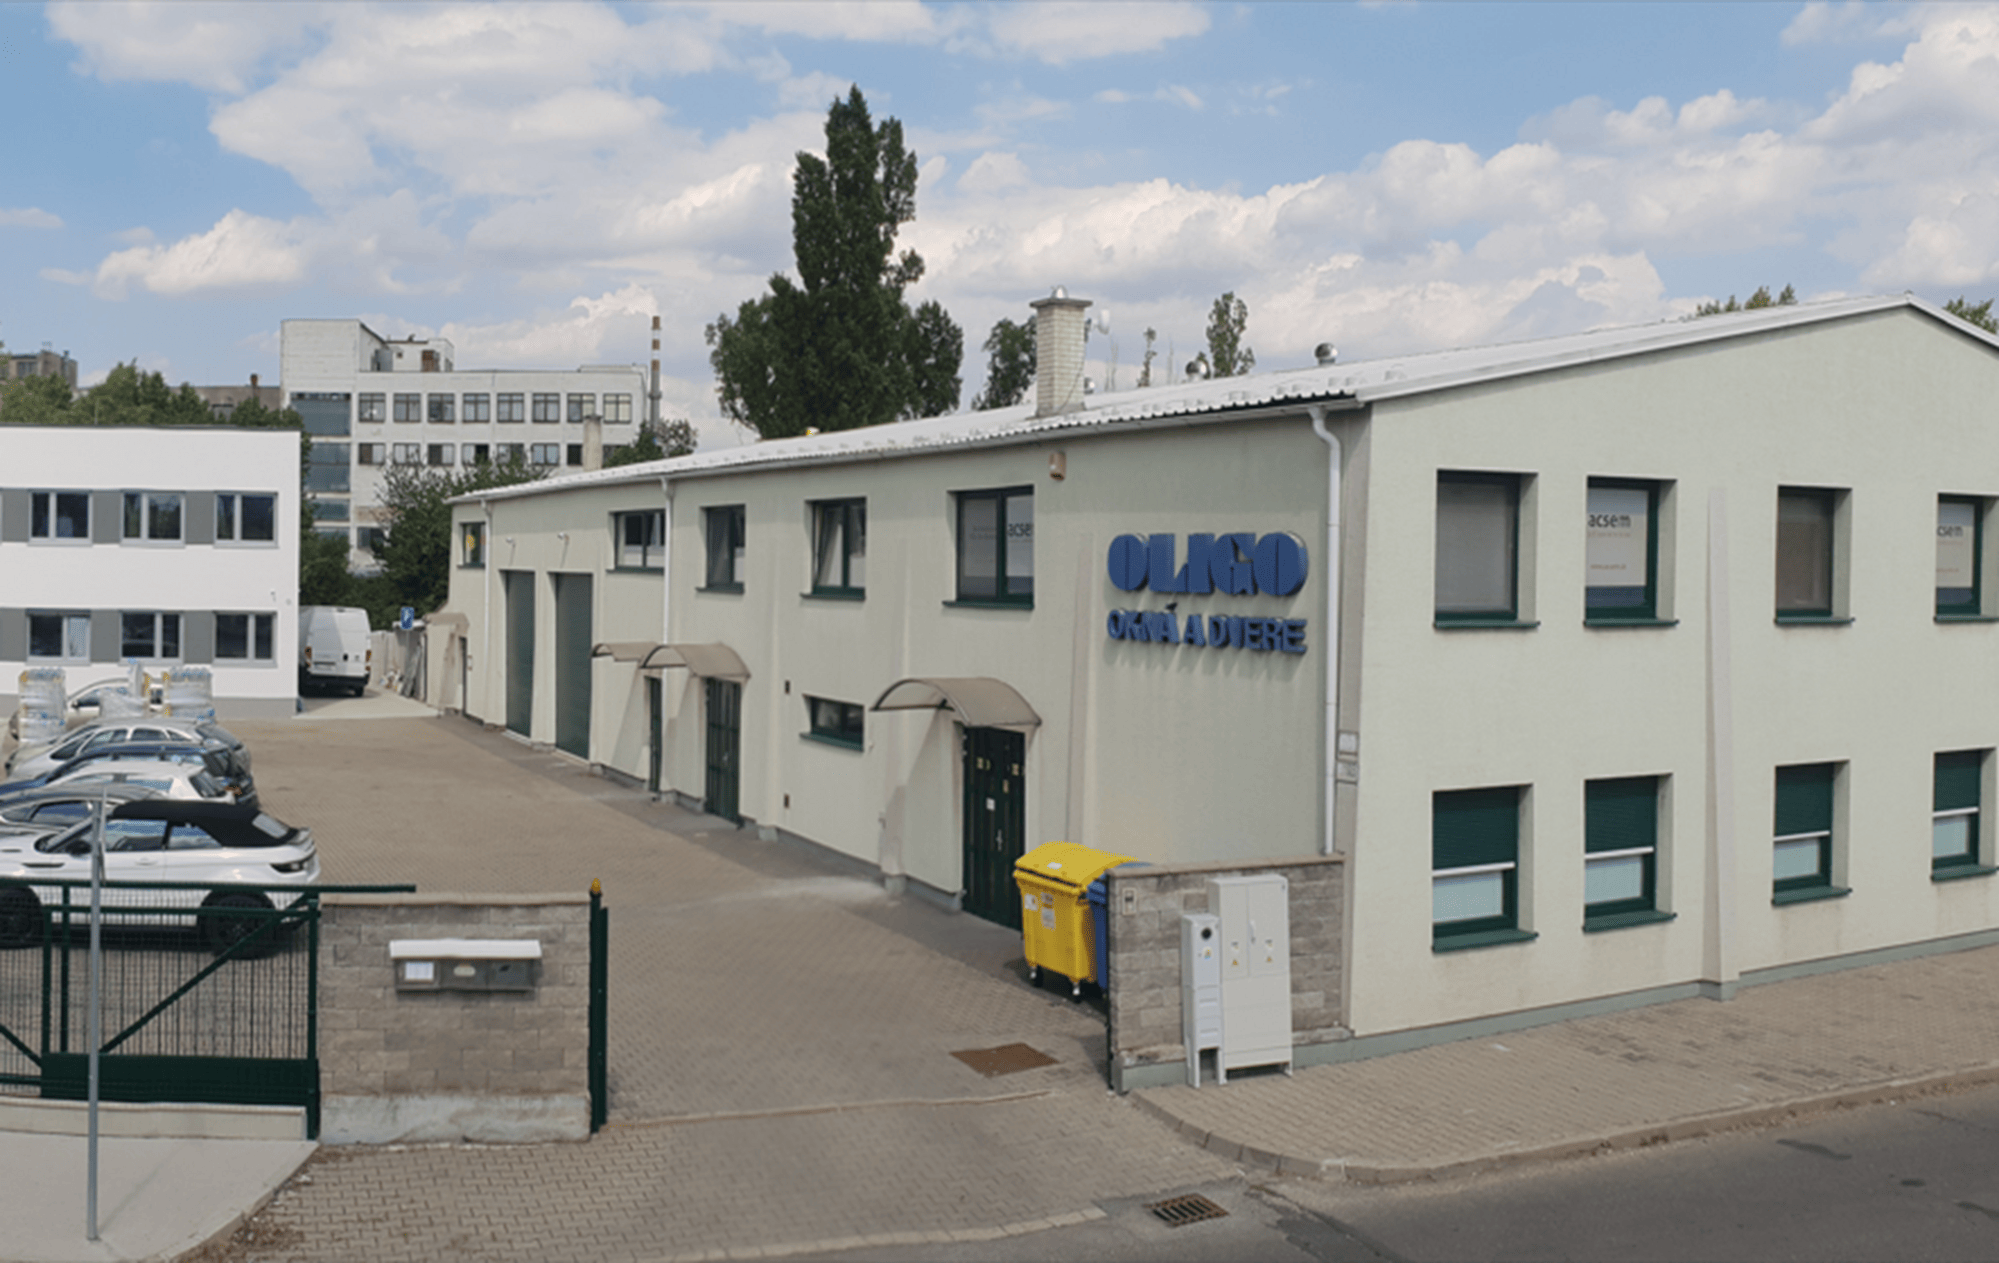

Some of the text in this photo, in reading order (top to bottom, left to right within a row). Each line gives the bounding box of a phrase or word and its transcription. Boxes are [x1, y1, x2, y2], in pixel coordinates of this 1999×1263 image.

[1588, 514, 1631, 528] acsem
[1107, 532, 1309, 596] OLIGO
[1107, 602, 1308, 655] OKNÁ A DVERE
